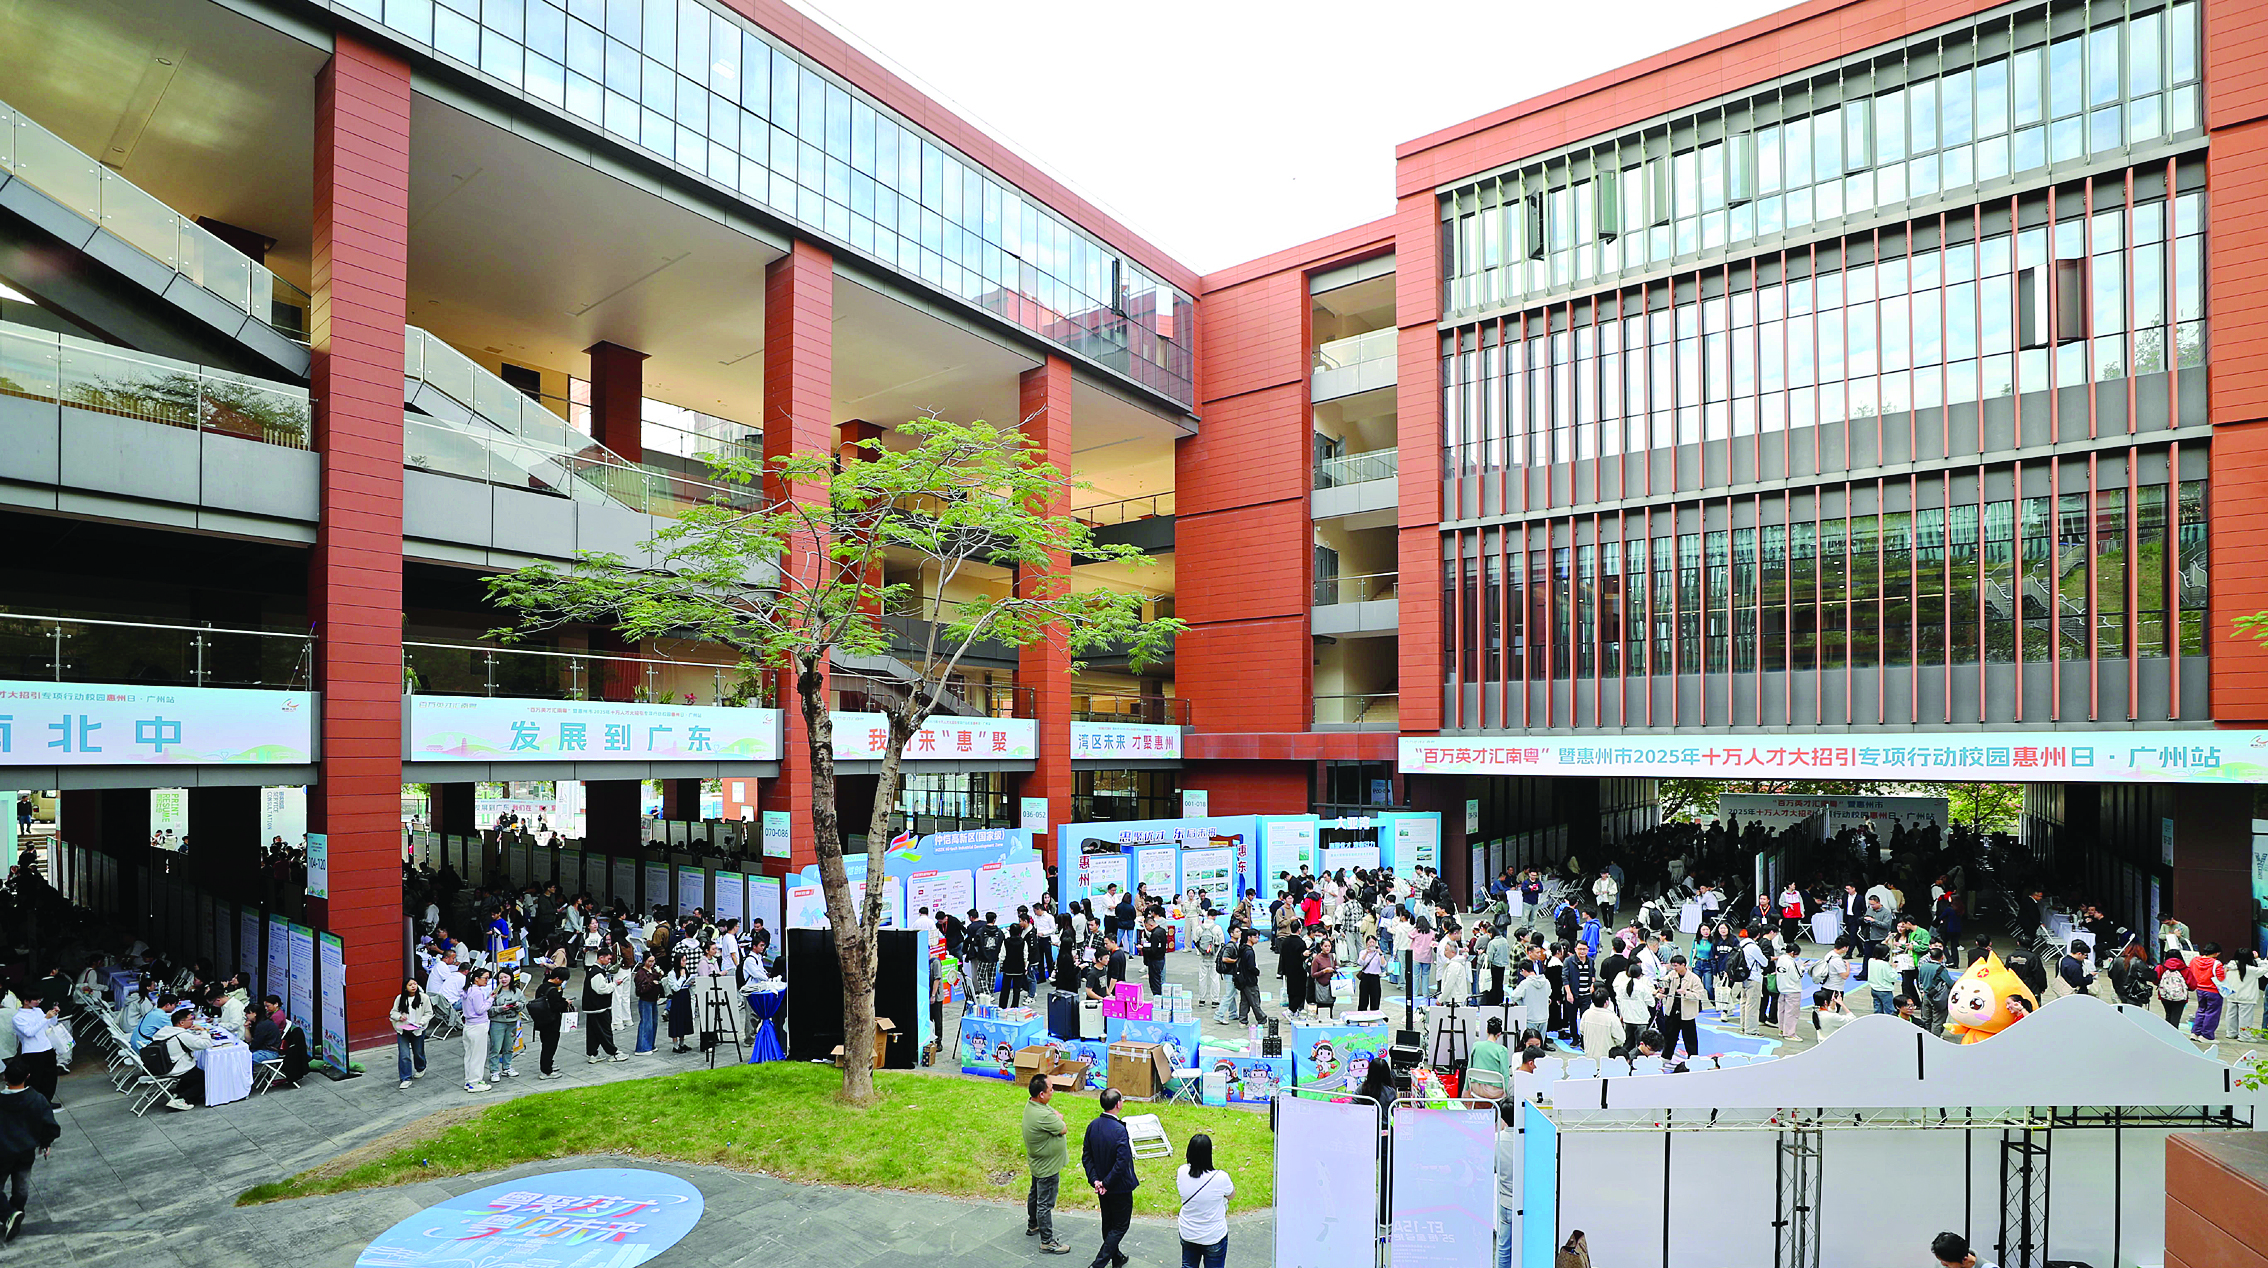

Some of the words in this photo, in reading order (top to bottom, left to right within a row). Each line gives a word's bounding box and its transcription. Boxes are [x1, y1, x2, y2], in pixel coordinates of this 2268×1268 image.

[0, 714, 181, 752] 北中
[508, 720, 713, 752] 发展到广东
[1078, 733, 1126, 750] 湾区未来
[1132, 735, 1174, 750] 才聚惠州
[171, 793, 180, 816] PRINT
[765, 828, 788, 837] 070-086
[1335, 816, 1370, 830] 大亚湾
[309, 857, 326, 871] 104-120
[1238, 844, 1247, 872] 惠东
[1078, 855, 1090, 887] 惠州
